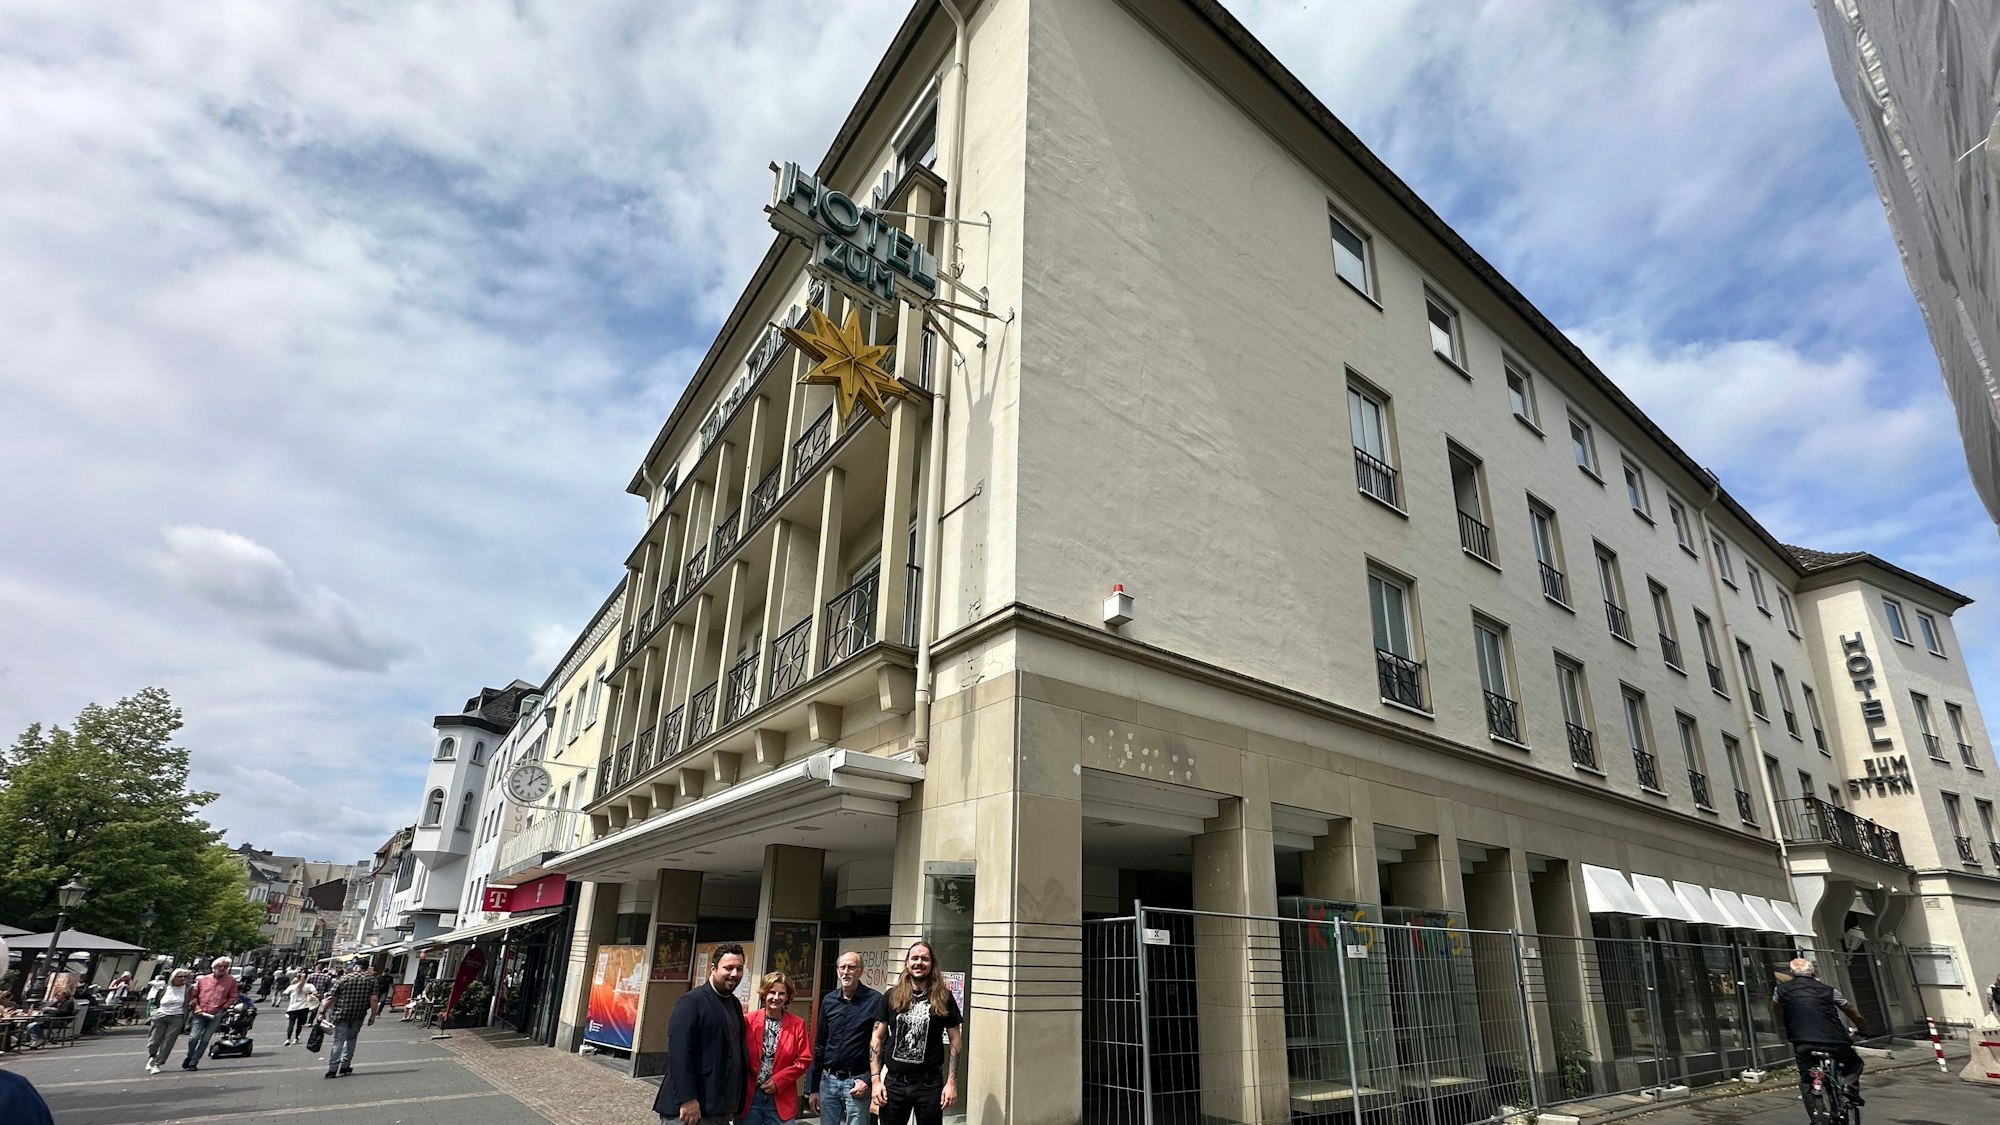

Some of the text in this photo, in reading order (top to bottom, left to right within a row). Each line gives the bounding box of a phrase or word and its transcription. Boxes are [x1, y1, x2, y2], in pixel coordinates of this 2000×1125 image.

[784, 160, 936, 290] HOTEL
[824, 234, 895, 300] ZUM
[1839, 631, 1892, 747] HOTEL
[1863, 755, 1908, 774] ZUM
[489, 891, 507, 908] T
